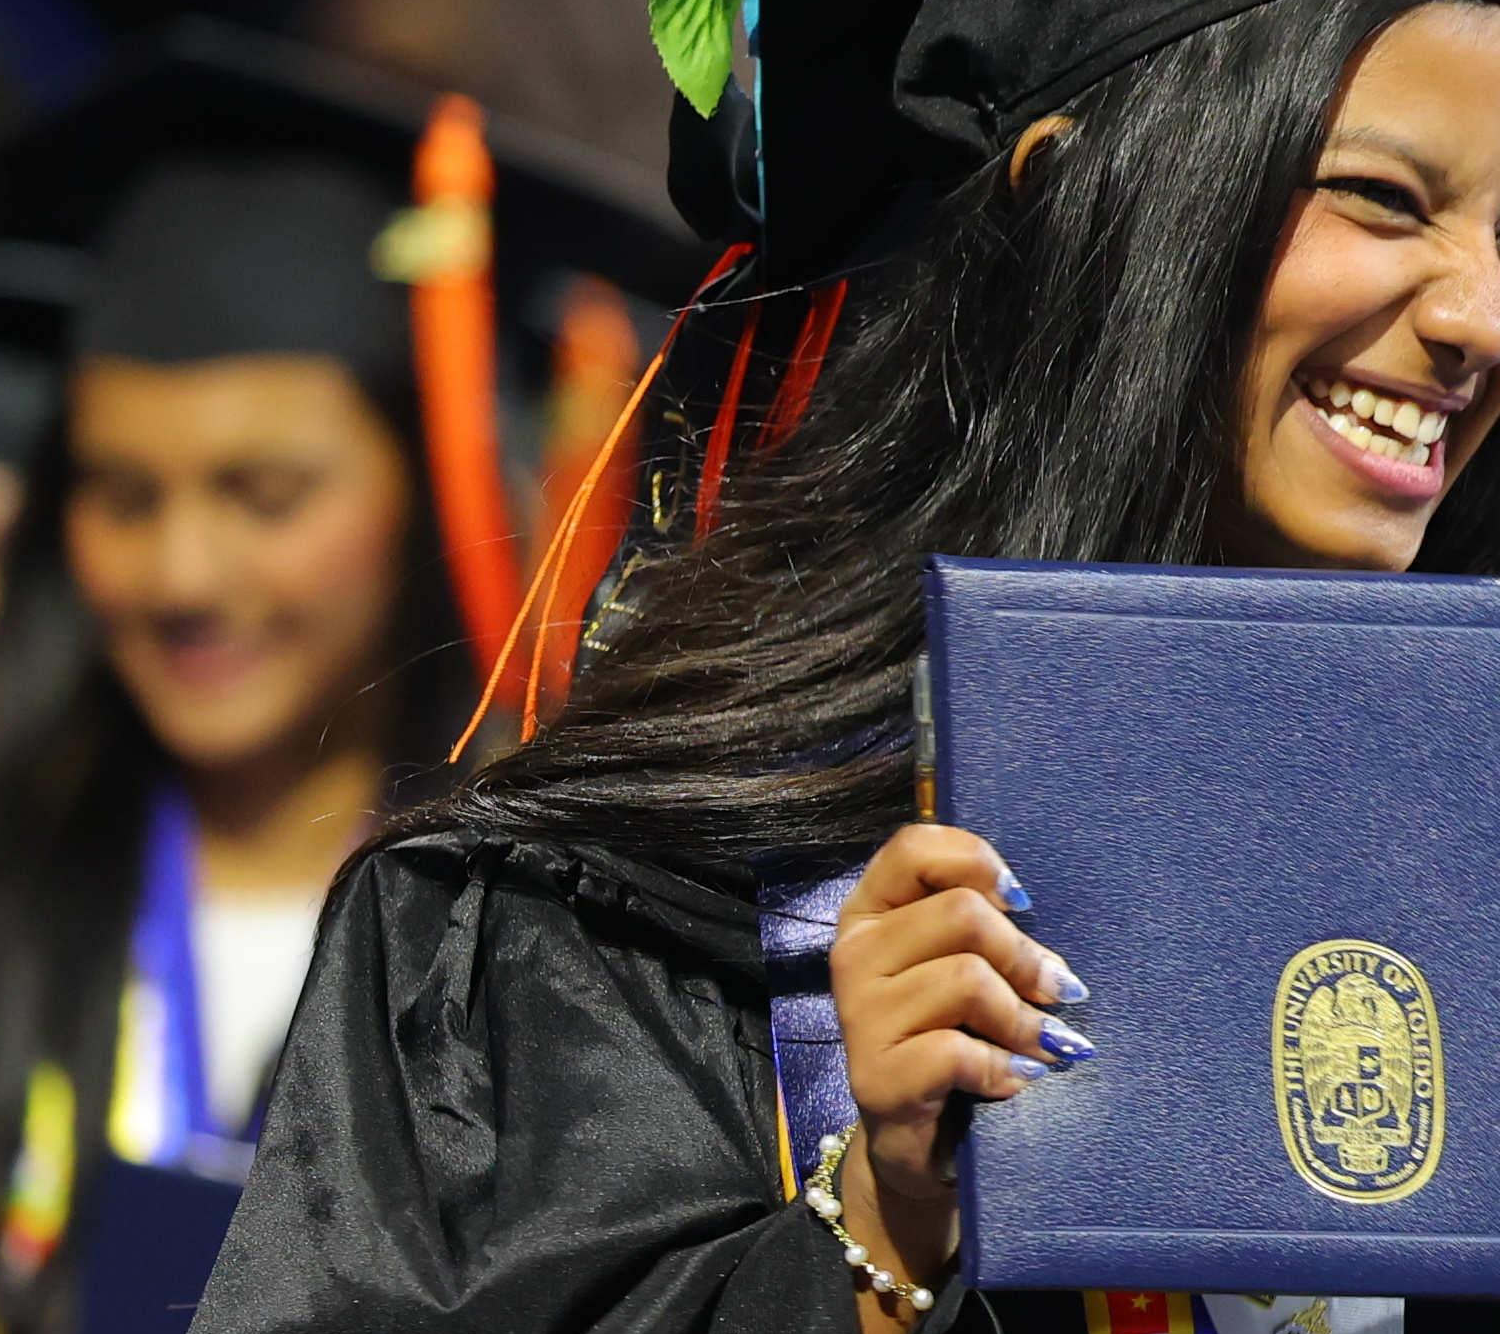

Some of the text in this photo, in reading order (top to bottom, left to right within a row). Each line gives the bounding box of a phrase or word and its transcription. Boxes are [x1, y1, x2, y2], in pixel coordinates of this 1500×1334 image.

[1284, 952, 1380, 1038] UNIVERSITY
[1382, 964, 1415, 993] OF
[1404, 996, 1433, 1099] TOLEDO
